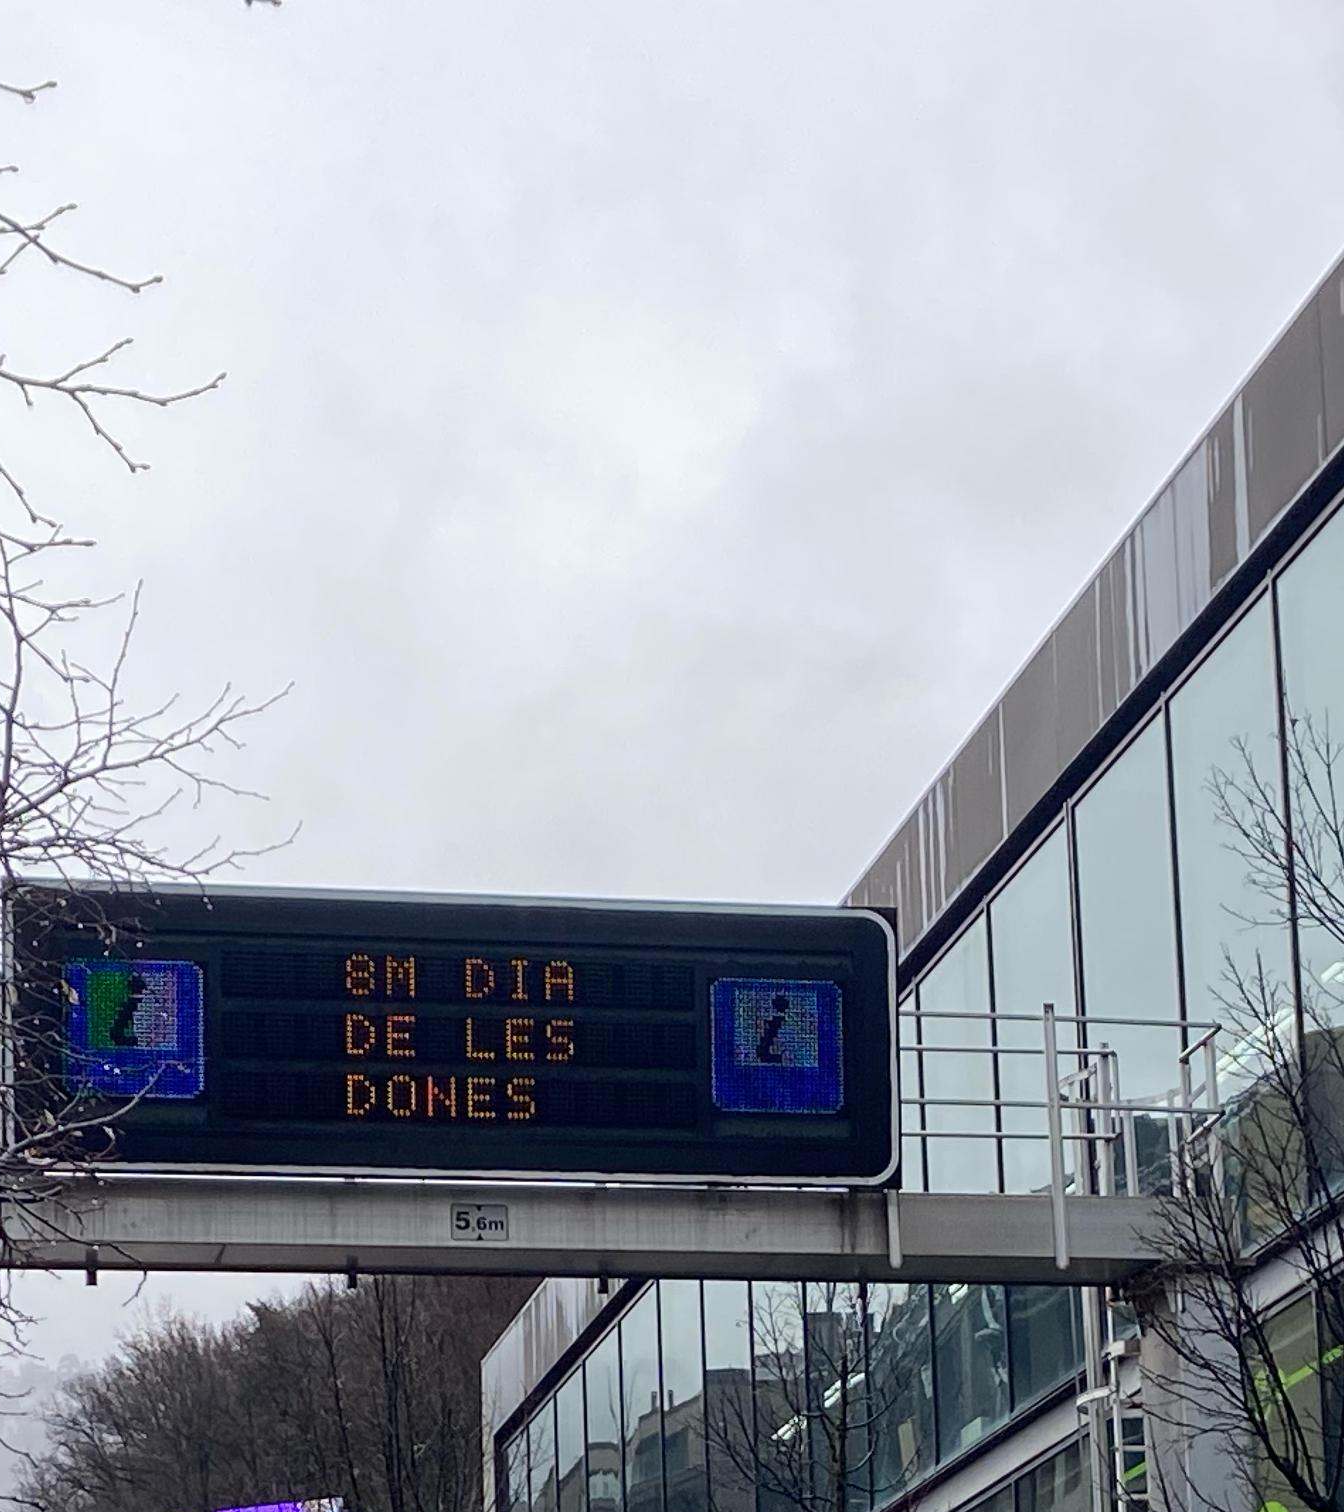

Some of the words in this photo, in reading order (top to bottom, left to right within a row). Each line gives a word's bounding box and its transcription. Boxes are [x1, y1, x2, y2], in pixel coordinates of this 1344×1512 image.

[346, 953, 416, 999] 8M
[465, 957, 575, 1001] DIA
[346, 1013, 416, 1057] DE
[465, 1017, 575, 1061] LES
[346, 1074, 536, 1120] DONES
